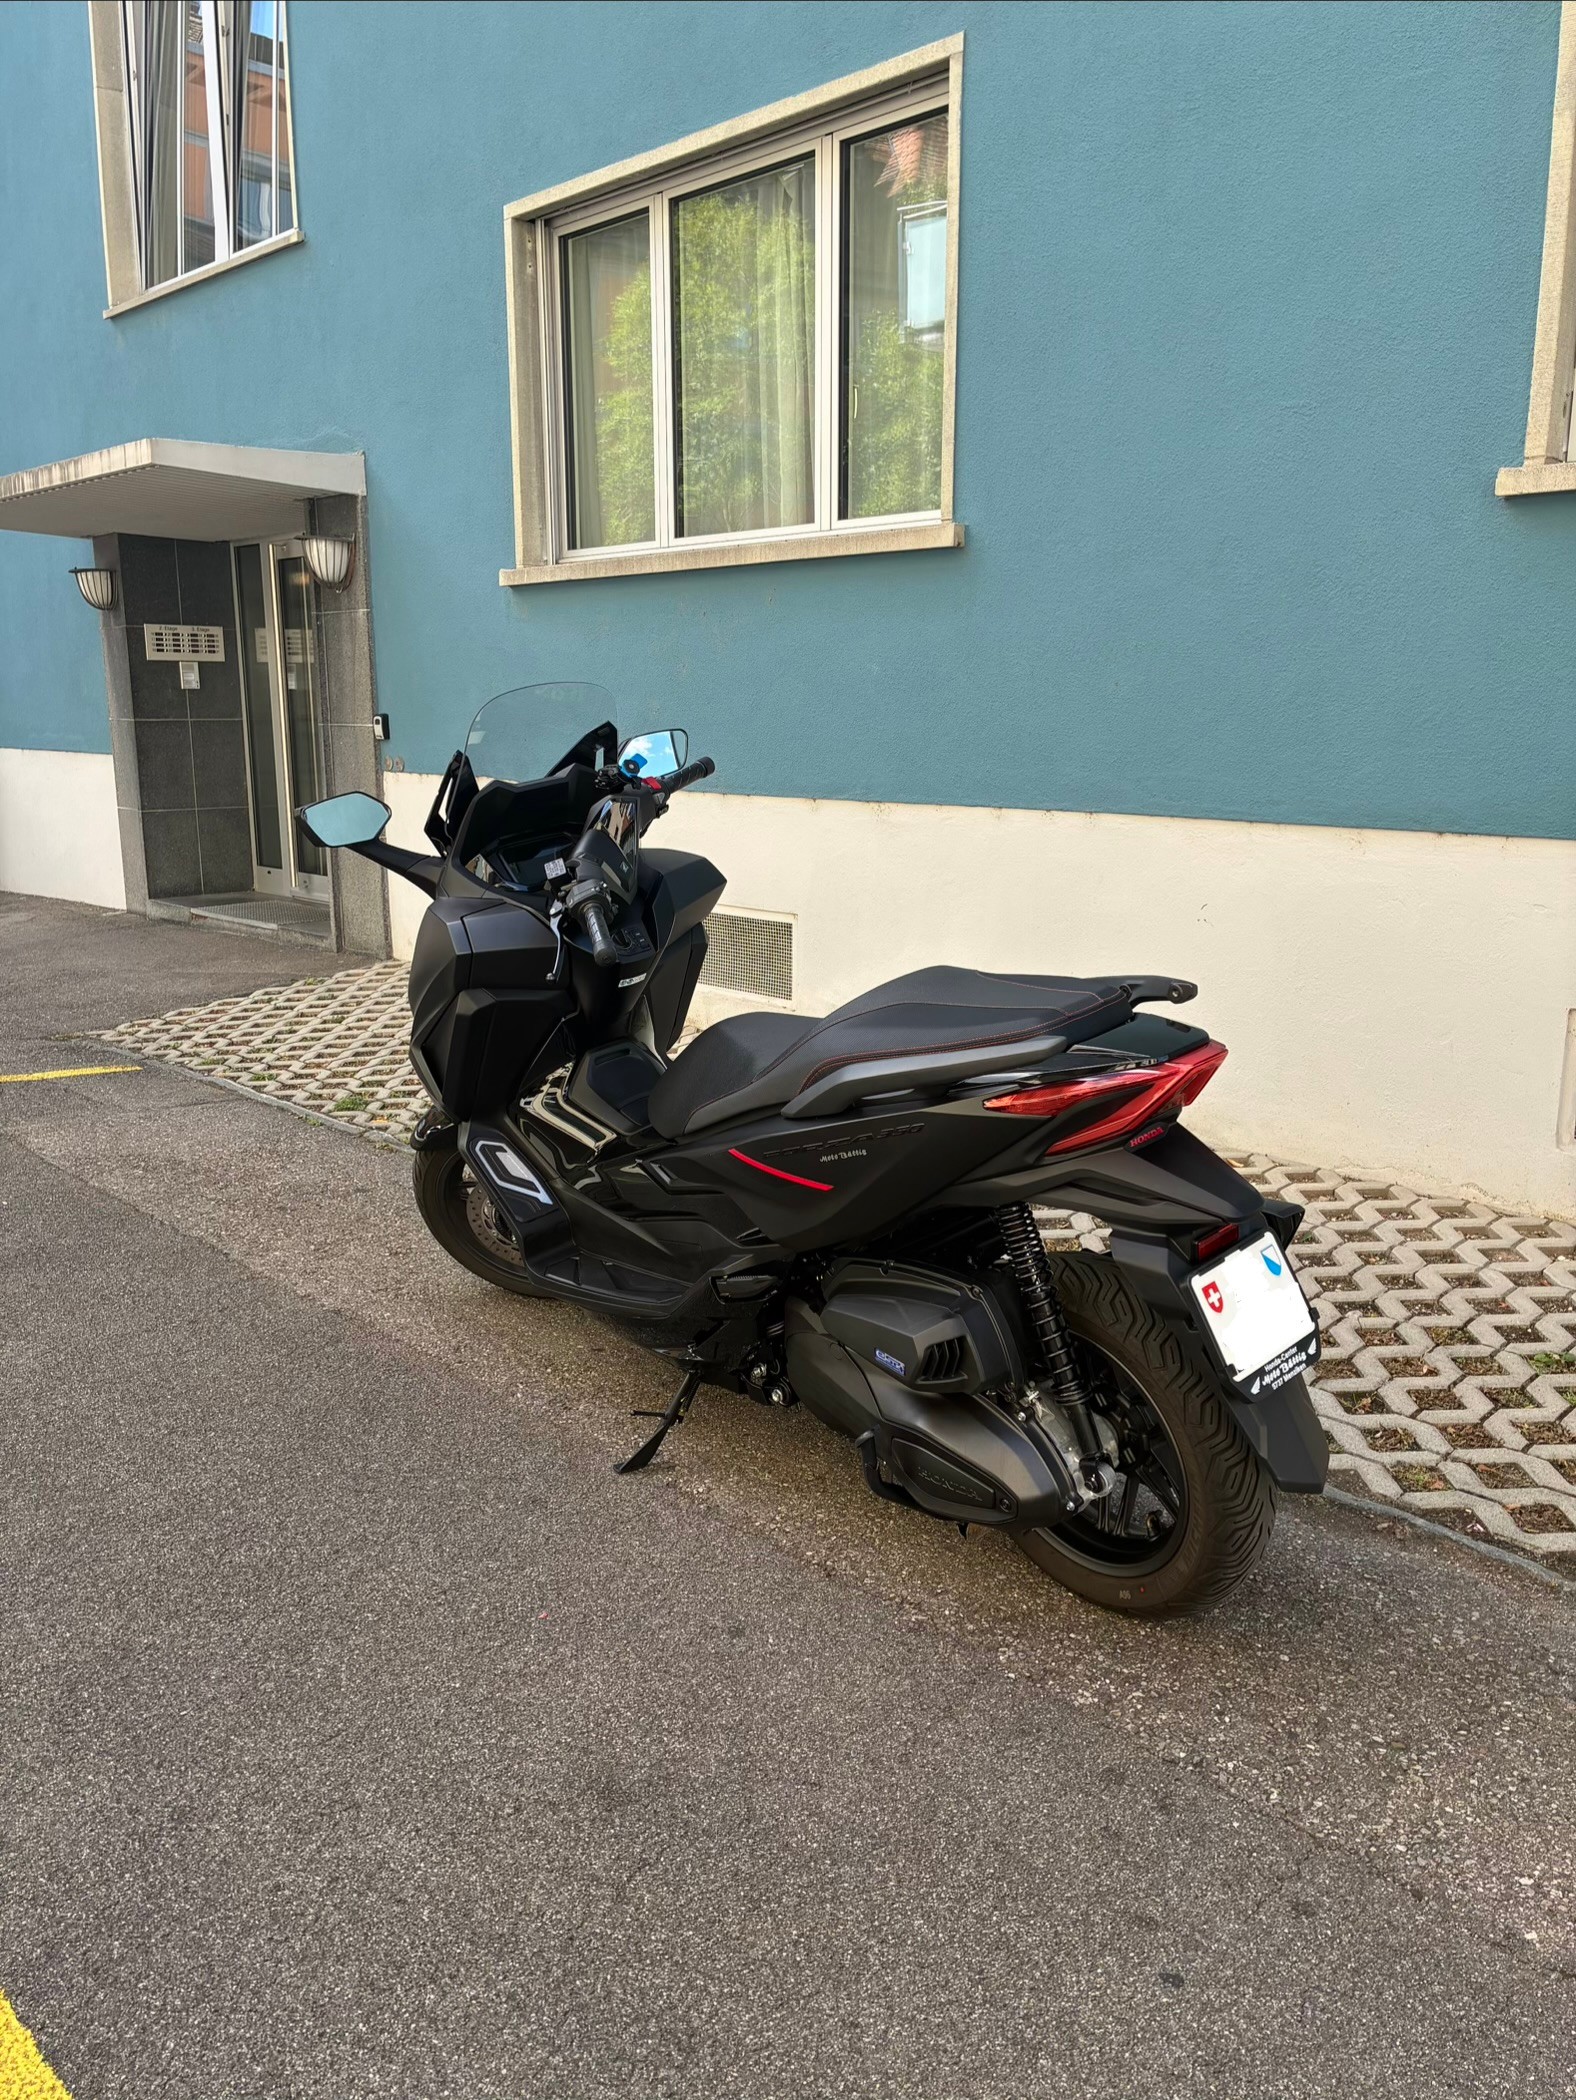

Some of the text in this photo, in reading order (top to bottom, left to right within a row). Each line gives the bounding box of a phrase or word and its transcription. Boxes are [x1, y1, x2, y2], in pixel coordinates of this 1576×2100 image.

[1130, 1126, 1164, 1147] HONDA
[819, 1153, 838, 1162] Moto
[1262, 1368, 1280, 1386] Moto
